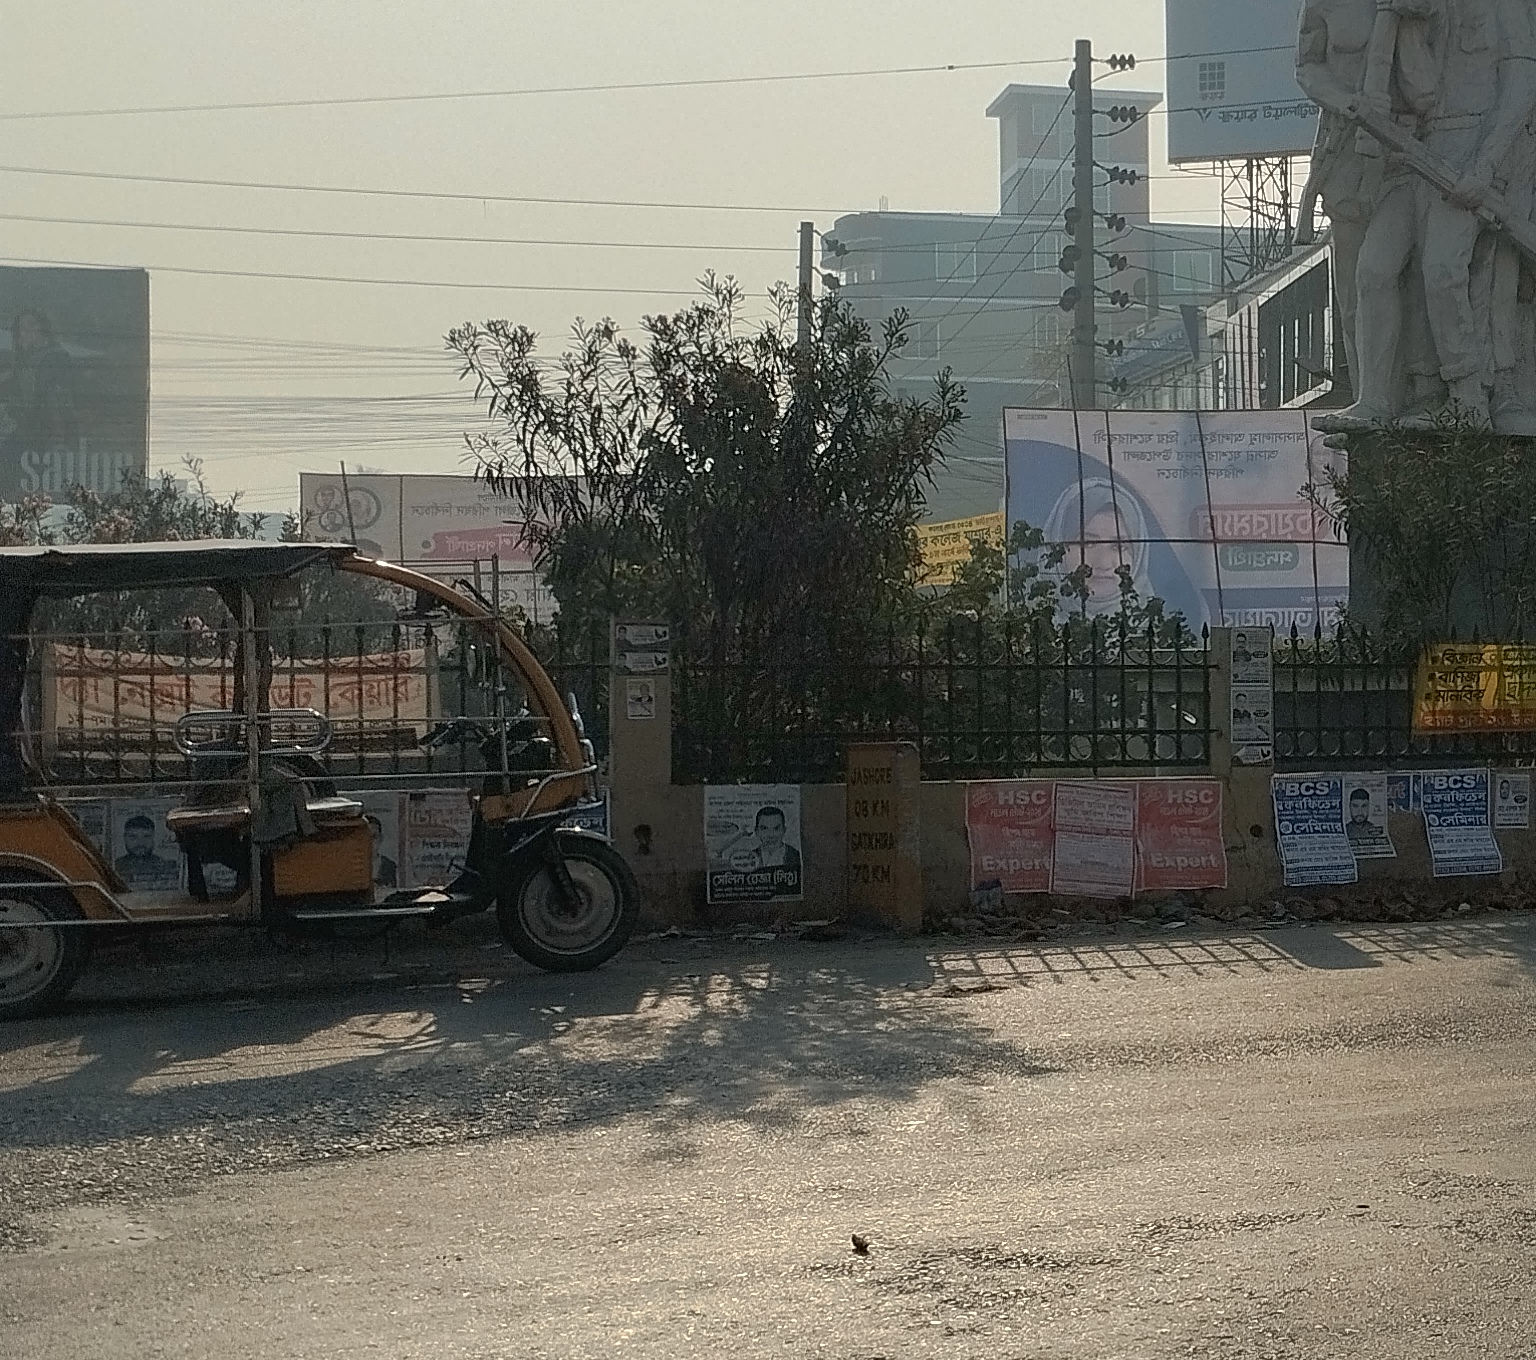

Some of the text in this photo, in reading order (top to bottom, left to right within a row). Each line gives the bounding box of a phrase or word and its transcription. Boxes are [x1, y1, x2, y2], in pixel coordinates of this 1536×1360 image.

[1218, 108, 1260, 123] স্কয়ার
[1285, 781, 1330, 797] BCS
[1434, 775, 1476, 790] BCS
[998, 789, 1047, 806] HSC
[1167, 789, 1214, 804] HSC
[871, 799, 891, 818] KM
[1293, 819, 1342, 834] সেমিনার
[1440, 812, 1487, 826] সেমিনার
[981, 854, 1051, 875] Expert
[1150, 853, 1218, 873] Expert
[871, 864, 891, 884] KM
